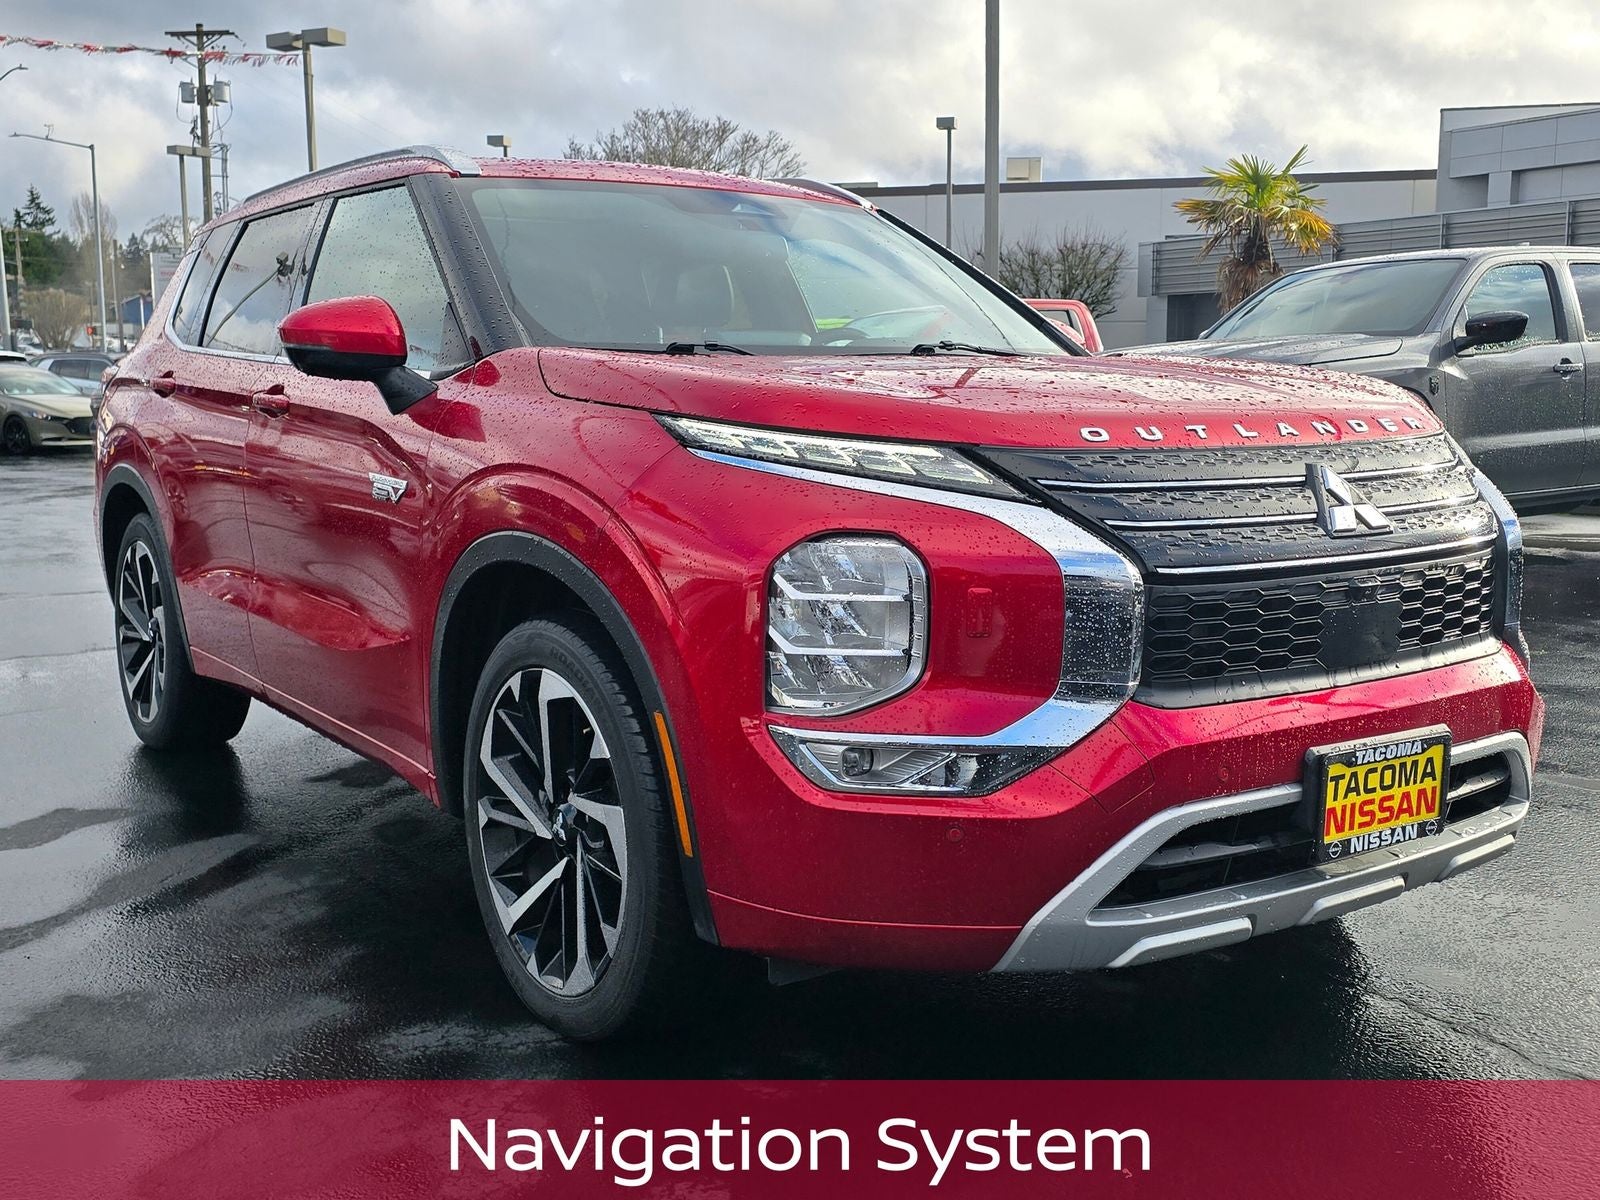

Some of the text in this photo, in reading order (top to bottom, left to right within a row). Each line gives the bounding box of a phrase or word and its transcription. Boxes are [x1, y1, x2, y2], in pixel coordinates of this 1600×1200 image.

[1080, 415, 1425, 442] OUTLANDER
[1356, 740, 1422, 765] TACOMA
[1330, 756, 1437, 802] TACOMA
[1324, 786, 1438, 837] NISSAN
[1350, 823, 1418, 854] NISSAN
